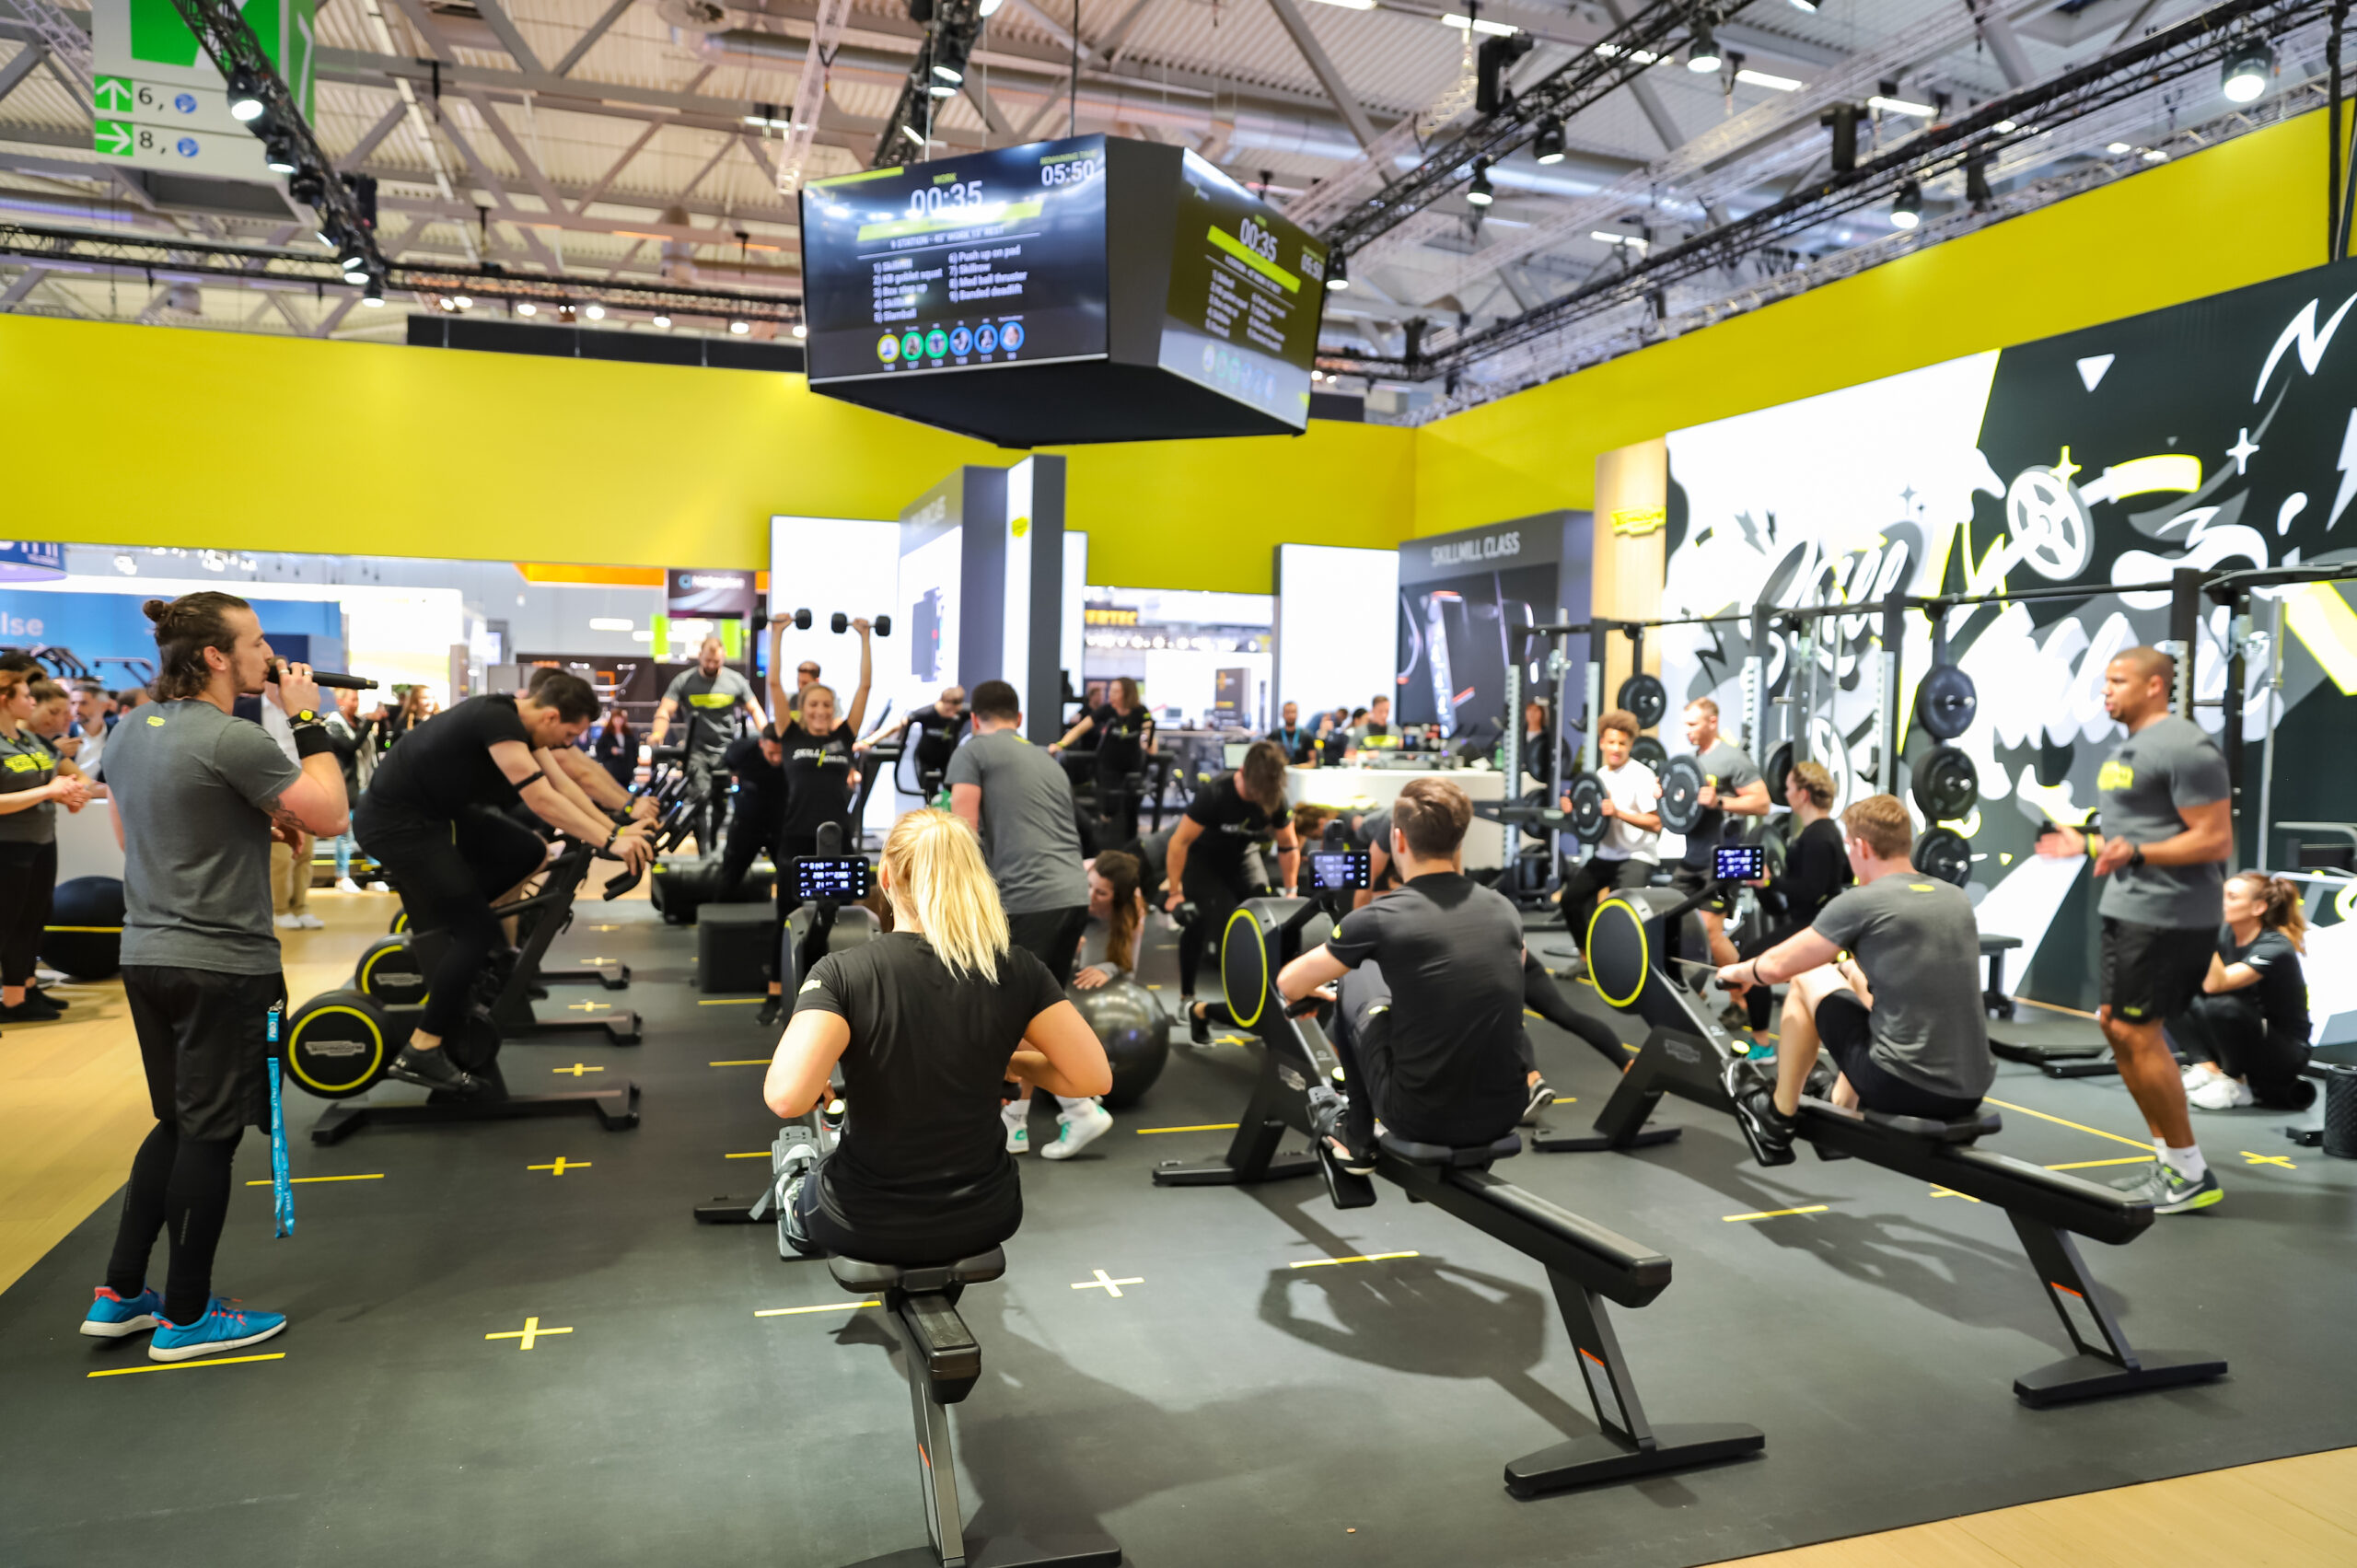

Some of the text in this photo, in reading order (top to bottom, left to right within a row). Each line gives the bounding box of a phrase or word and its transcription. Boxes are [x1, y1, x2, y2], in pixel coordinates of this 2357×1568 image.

[1041, 159, 1094, 186] 05:50
[911, 180, 982, 217] 00:35
[1239, 218, 1278, 262] 00:35
[958, 250, 980, 262] Push
[980, 250, 992, 261] up
[992, 249, 1004, 258] on
[1004, 244, 1021, 259] pad
[958, 262, 992, 275] Skillrow
[958, 275, 978, 287] Med
[978, 273, 993, 285] ball
[994, 271, 1028, 284] thruster
[958, 286, 990, 300] Banded
[990, 283, 1023, 296] deadlift
[1431, 531, 1521, 567] SKILLMILL CLASS
